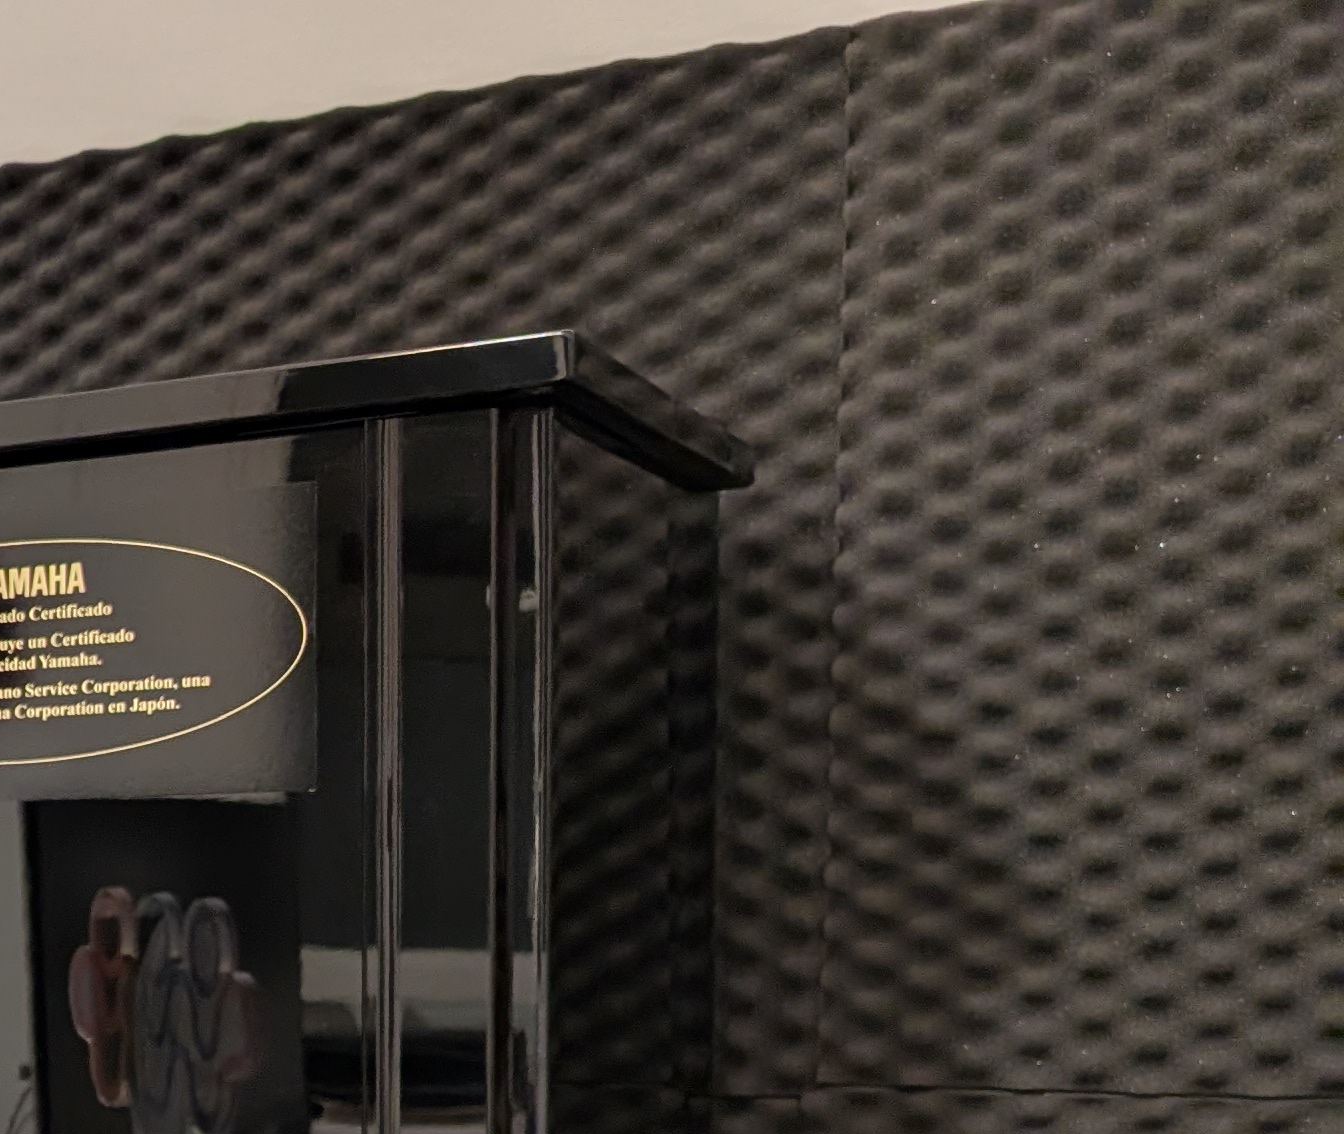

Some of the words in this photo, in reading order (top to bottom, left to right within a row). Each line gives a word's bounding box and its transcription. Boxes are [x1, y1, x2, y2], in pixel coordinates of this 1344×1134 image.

[29, 601, 113, 622] Certificado
[28, 638, 47, 650] un
[50, 627, 136, 648] Certificado
[39, 651, 103, 670] Yamaha.
[25, 680, 78, 698] Service
[81, 675, 179, 696] Corporation,
[181, 674, 212, 688] una
[14, 700, 105, 721] Corporation
[108, 701, 127, 714] en
[129, 696, 182, 715] Japón.
